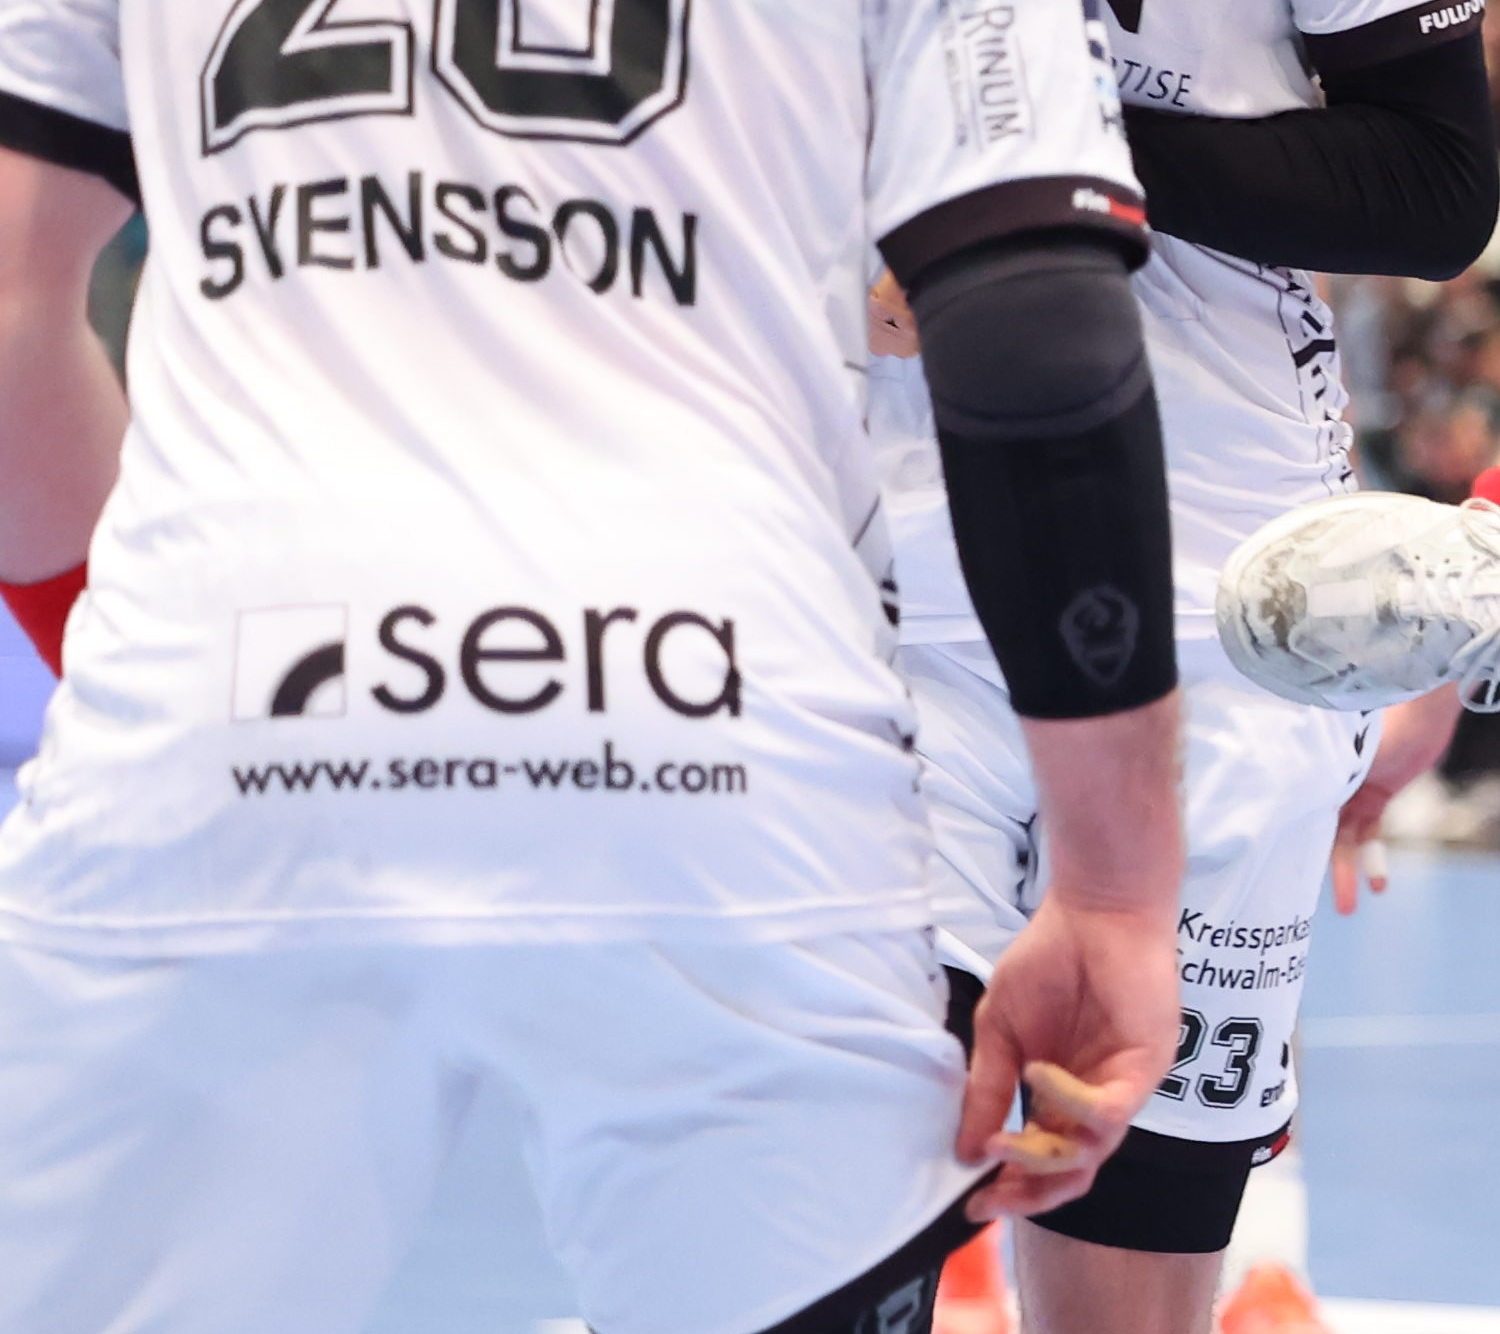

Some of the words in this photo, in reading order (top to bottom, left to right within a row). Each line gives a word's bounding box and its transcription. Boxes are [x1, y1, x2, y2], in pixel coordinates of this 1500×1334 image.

[200, 171, 697, 306] SVENSSON
[370, 603, 742, 718] sera
[231, 740, 748, 797] www.sera-web.com
